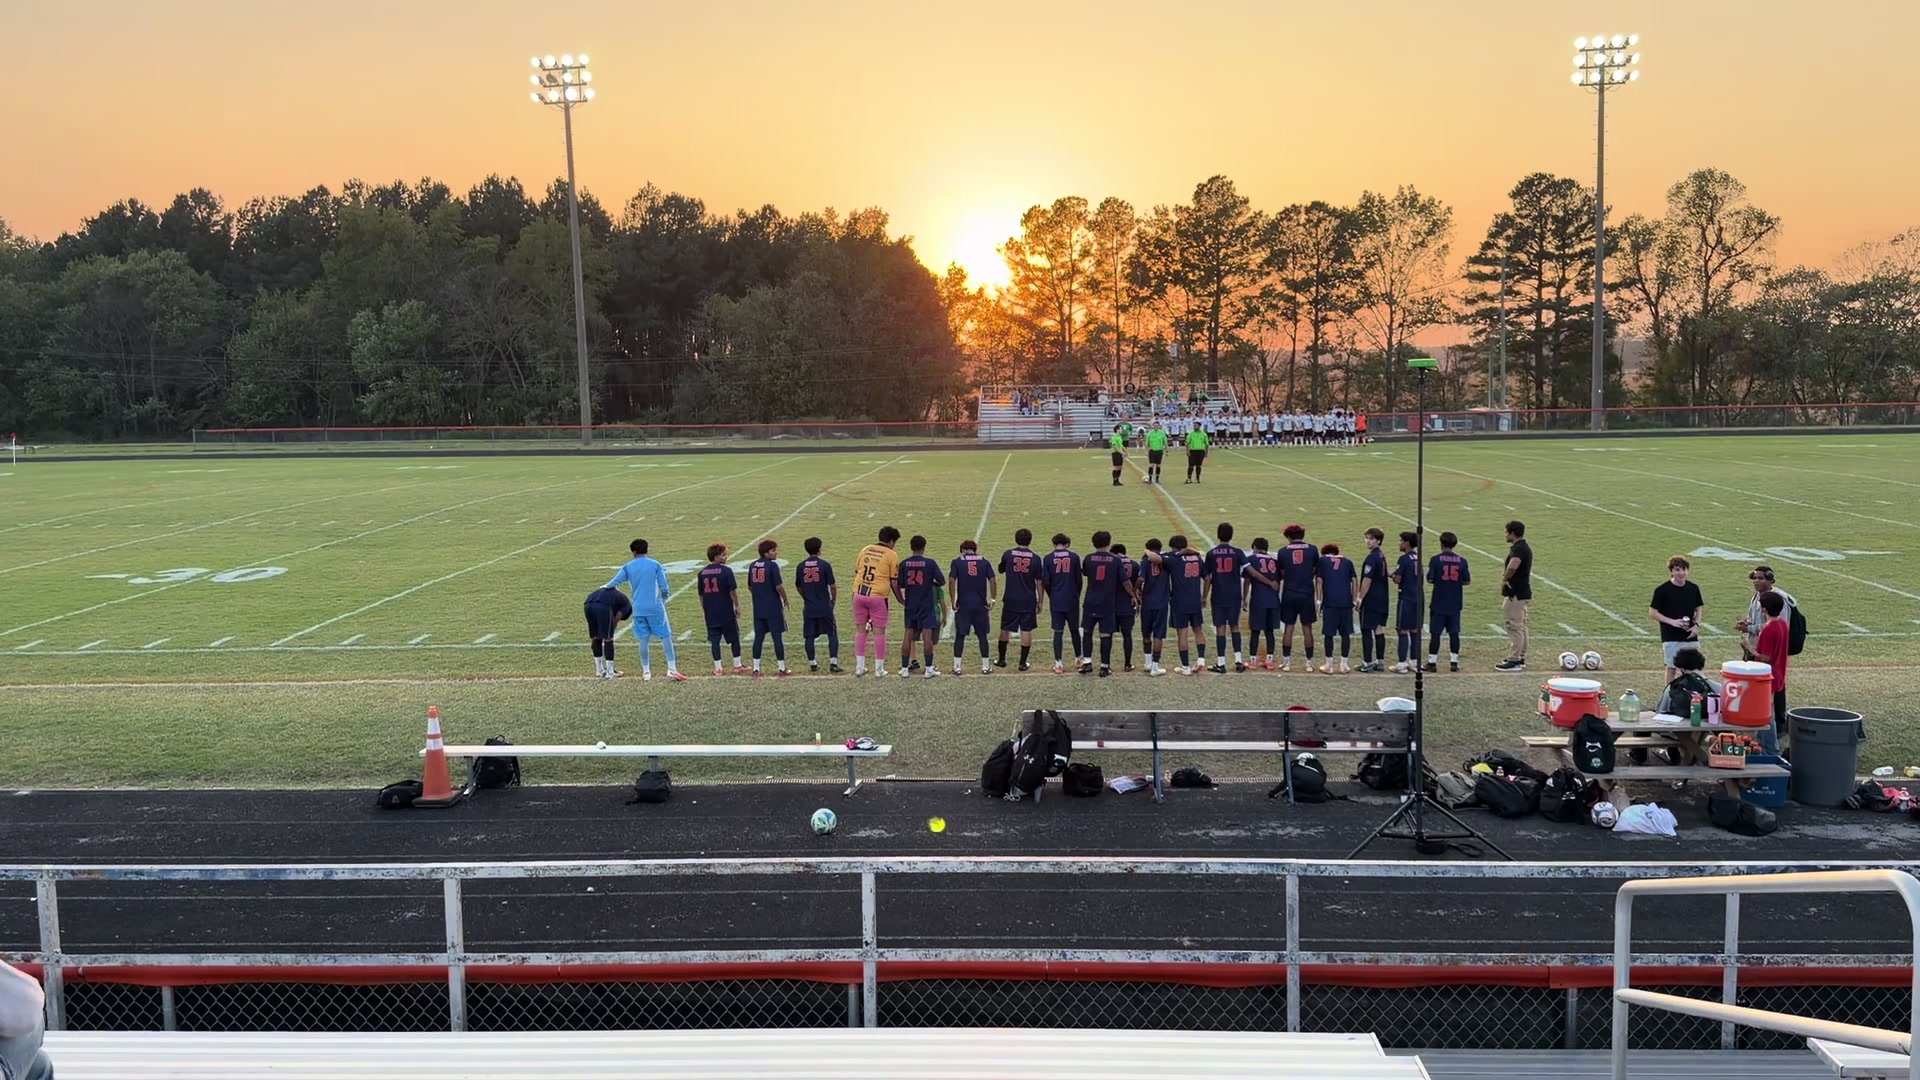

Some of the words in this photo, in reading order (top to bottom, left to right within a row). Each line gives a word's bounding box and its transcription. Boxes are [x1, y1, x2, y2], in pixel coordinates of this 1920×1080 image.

[967, 561, 978, 576] 5
[1013, 557, 1031, 573] 32
[1053, 557, 1071, 573] 70
[1259, 558, 1277, 574] 14
[1331, 556, 1341, 570] 7
[128, 567, 289, 584] 30
[752, 567, 766, 583] 16
[803, 567, 820, 583] 25
[862, 565, 876, 582] 15
[907, 569, 925, 586] 24
[1441, 565, 1460, 581] 15
[703, 577, 720, 593] 11
